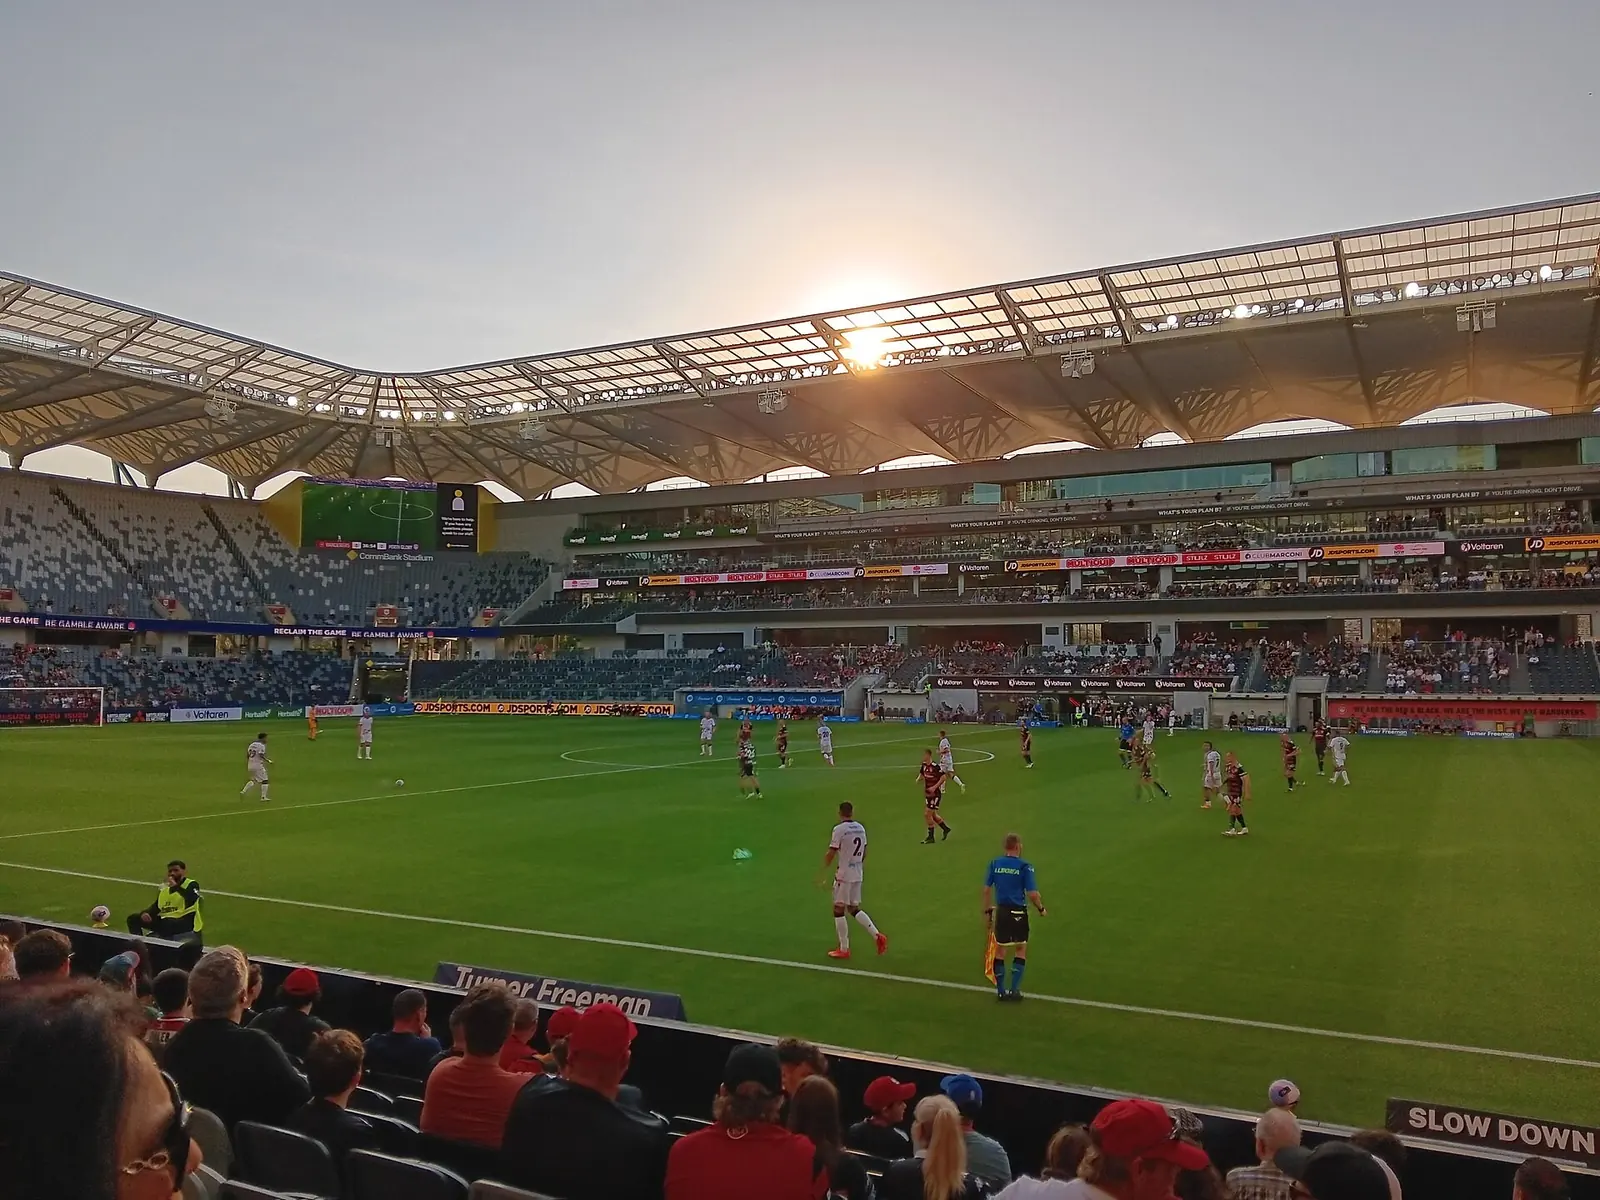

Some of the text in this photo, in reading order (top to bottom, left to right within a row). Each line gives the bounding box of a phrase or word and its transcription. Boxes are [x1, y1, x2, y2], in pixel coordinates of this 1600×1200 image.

[360, 552, 402, 560] CommBank
[1328, 548, 1376, 556] JDSPORTS.COM
[58, 620, 94, 628] GAMBLE
[96, 622, 124, 630] AWARE
[424, 704, 490, 712] JDSPORTS.COM
[194, 710, 229, 719] Voltaren
[852, 836, 862, 856] 2
[456, 966, 651, 1017] Tuer Freeman
[1408, 1107, 1596, 1154] SLOW DOWN
